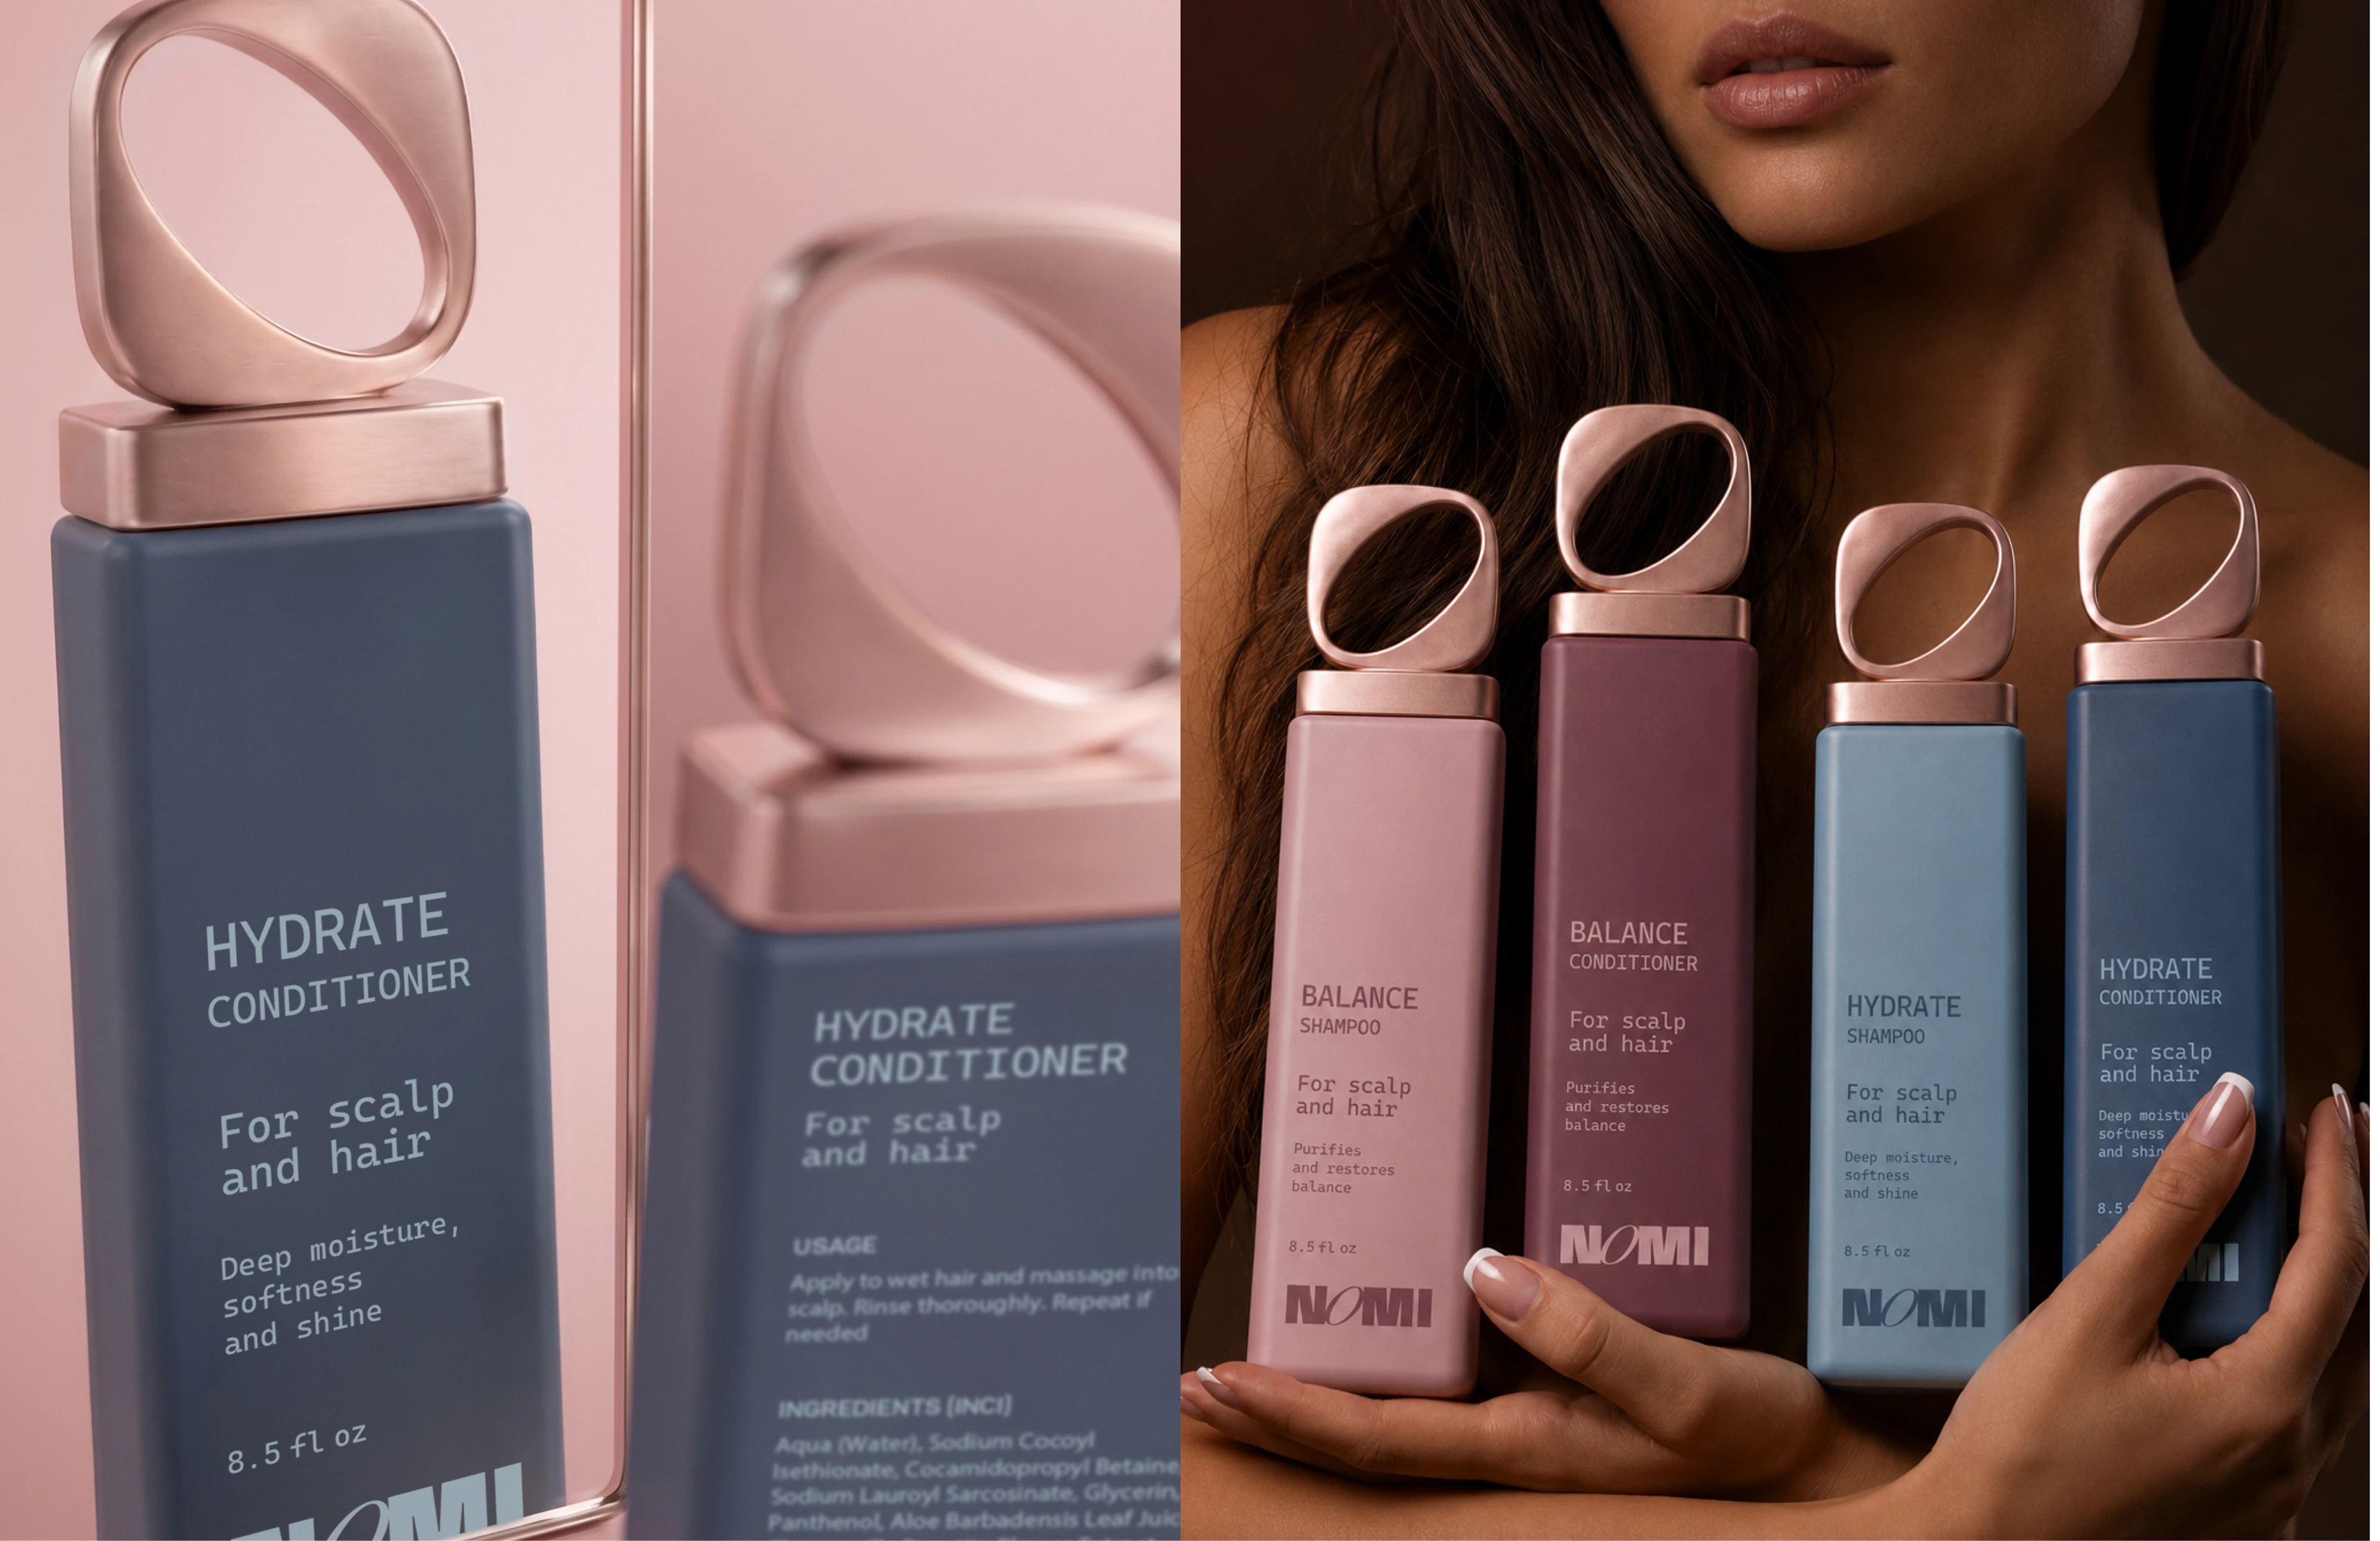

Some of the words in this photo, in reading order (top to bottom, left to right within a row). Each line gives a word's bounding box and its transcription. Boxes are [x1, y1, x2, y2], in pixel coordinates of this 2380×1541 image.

[206, 891, 449, 972] HYDRATE
[1571, 921, 1688, 945] BALANCE
[1569, 954, 1698, 972] CONDITIONER
[2100, 958, 2213, 980] HYDRATE
[208, 957, 471, 1028] CONDITIONER
[1302, 984, 1418, 1009] BALANCE
[2099, 990, 2222, 1005] CONDITIONER
[1848, 994, 1961, 1018] HYDRATE
[814, 1002, 1015, 1043] HYDRATE
[1300, 1017, 1381, 1035] SHAMPOO
[1571, 1011, 1608, 1029] For
[1623, 1012, 1686, 1034] scalp
[1569, 1034, 1607, 1051] and
[1621, 1034, 1673, 1053] hair
[1847, 1028, 1925, 1044] SHAMPOO
[2102, 1043, 2138, 1060] For
[2151, 1042, 2211, 1064] scalp
[810, 1042, 1129, 1087] CONDITIONER
[2100, 1065, 2136, 1082] and
[2151, 1065, 2200, 1082] hair
[1298, 1075, 1336, 1092] For
[1349, 1077, 1411, 1099] scalp
[1566, 1081, 1636, 1094] Purifies
[1847, 1084, 1884, 1100] For
[1897, 1084, 1957, 1105] scalp
[220, 1109, 299, 1149] For
[329, 1079, 454, 1129] scalp
[1297, 1097, 1334, 1115] and
[1347, 1098, 1398, 1117] hair
[1566, 1100, 1591, 1112] and
[1600, 1101, 1670, 1113] restores
[1846, 1105, 1882, 1123] and
[1896, 1105, 1945, 1123] hair
[2099, 1110, 2131, 1124] Deep
[2140, 1110, 2188, 1122] moistu
[805, 1112, 870, 1137] For
[892, 1105, 1002, 1136] scalp
[1565, 1118, 1626, 1131] balance
[2099, 1128, 2164, 1139] softness
[802, 1139, 868, 1167] and
[888, 1138, 977, 1164] hair
[1294, 1143, 1362, 1156] Purifies
[1845, 1151, 1877, 1166] Deep
[1885, 1151, 1958, 1166] moisture,
[2099, 1146, 2123, 1157] and
[2131, 1146, 2164, 1157] shin
[222, 1146, 300, 1196] and
[331, 1127, 431, 1174] hair
[1292, 1161, 1318, 1174] and
[1327, 1163, 1395, 1175] restores
[1564, 1179, 1590, 1192] 8.5
[1595, 1179, 1611, 1192] fl
[1615, 1183, 1632, 1193] oz
[1845, 1169, 1910, 1181] softness
[1292, 1180, 1352, 1193] balance
[1844, 1186, 1869, 1199] and
[1877, 1187, 1919, 1200] shine
[2097, 1203, 2122, 1214] 8.5
[221, 1249, 291, 1281] Deep
[310, 1216, 458, 1262] moisture,
[793, 1235, 878, 1257] USAGE
[1289, 1240, 1315, 1253] 8.5
[1319, 1241, 1334, 1253] fl
[1340, 1244, 1357, 1254] oz
[1560, 1224, 1709, 1267] NOMI
[1844, 1245, 1869, 1257] 8.5
[1874, 1245, 1889, 1257] fl
[1894, 1248, 1910, 1257] oz
[790, 1272, 853, 1295] Apply
[860, 1272, 883, 1291] to
[887, 1269, 929, 1290] wet
[934, 1265, 976, 1288] hair
[981, 1264, 1025, 1287] and
[1030, 1266, 1128, 1288] massage
[1132, 1263, 1179, 1283] into
[224, 1271, 363, 1318] softness
[788, 1296, 848, 1322] scalp.
[854, 1296, 912, 1317] Rinse
[917, 1292, 1047, 1319] thoroughly.
[1052, 1292, 1130, 1316] Repeat
[1135, 1289, 1153, 1309] if
[1285, 1284, 1433, 1328] NOMI
[1842, 1288, 1986, 1328] NOMI
[224, 1322, 276, 1355] and
[297, 1303, 382, 1339] shine
[785, 1323, 869, 1344] needed
[778, 1396, 942, 1419] INGREDIENTS
[228, 1441, 281, 1474] 8.5
[290, 1430, 324, 1458] fl
[334, 1424, 367, 1448] oz
[775, 1436, 832, 1457] Aqua
[838, 1434, 922, 1455] (Water),
[928, 1431, 1013, 1452] Sodium
[1018, 1429, 1095, 1453] Cocoyl
[772, 1460, 899, 1482] Isethionate,
[904, 1458, 1091, 1482] Cocamidopropyl
[230, 1462, 524, 1540] OMI
[771, 1487, 854, 1507] Sodium
[859, 1486, 941, 1508] Lauroyl
[946, 1483, 1077, 1504] Sarcosinate,
[767, 1514, 884, 1532] Panthenol,
[890, 1511, 942, 1530] Aloe
[946, 1510, 1078, 1529] Barbadensis
[1084, 1508, 1134, 1529] Leaf
